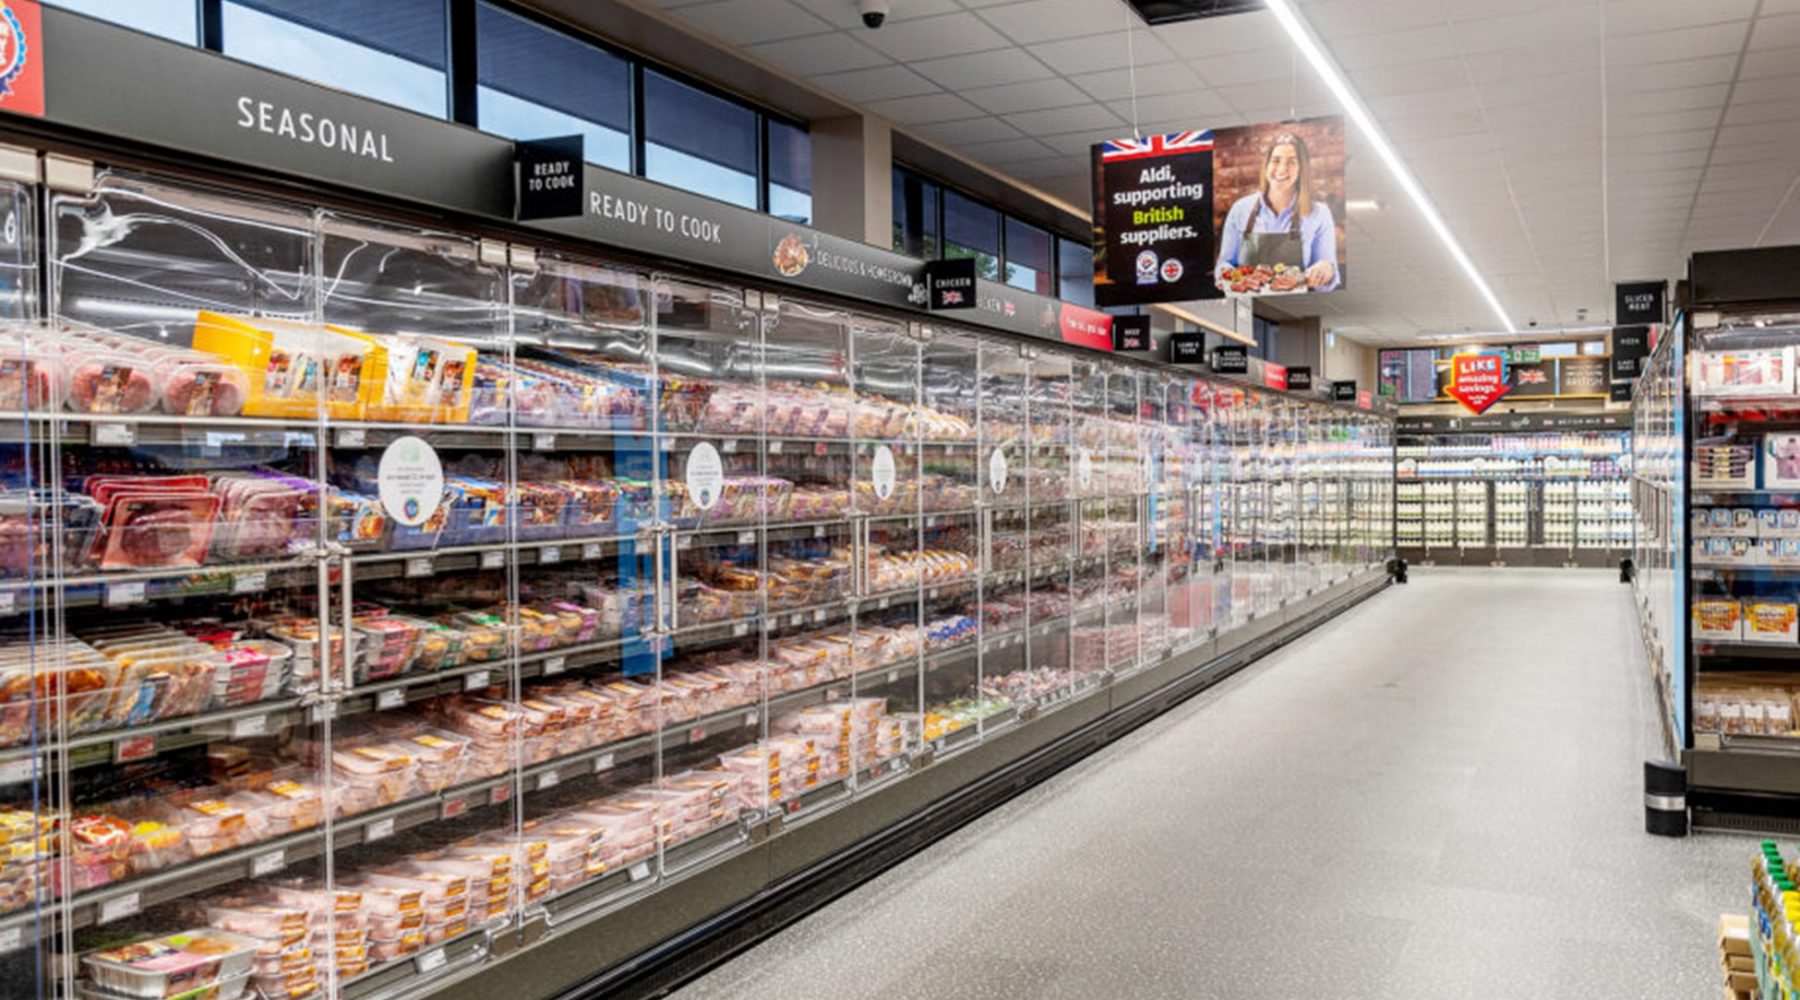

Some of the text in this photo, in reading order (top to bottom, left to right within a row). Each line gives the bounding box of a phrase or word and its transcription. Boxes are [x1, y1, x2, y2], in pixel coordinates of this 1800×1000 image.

[237, 96, 394, 163] SEASONAL
[534, 161, 570, 176] READY
[1139, 165, 1176, 184] Aldi,
[529, 175, 575, 191] TO COOK
[1113, 182, 1204, 206] supporting
[590, 191, 721, 243] READY TO COOK
[1133, 206, 1185, 225] British
[1120, 225, 1198, 246] suppliers.
[935, 277, 972, 288] CHICKEN
[1460, 359, 1496, 373] LIKE
[1458, 373, 1499, 384] amazing
[1458, 384, 1498, 394] savings.
